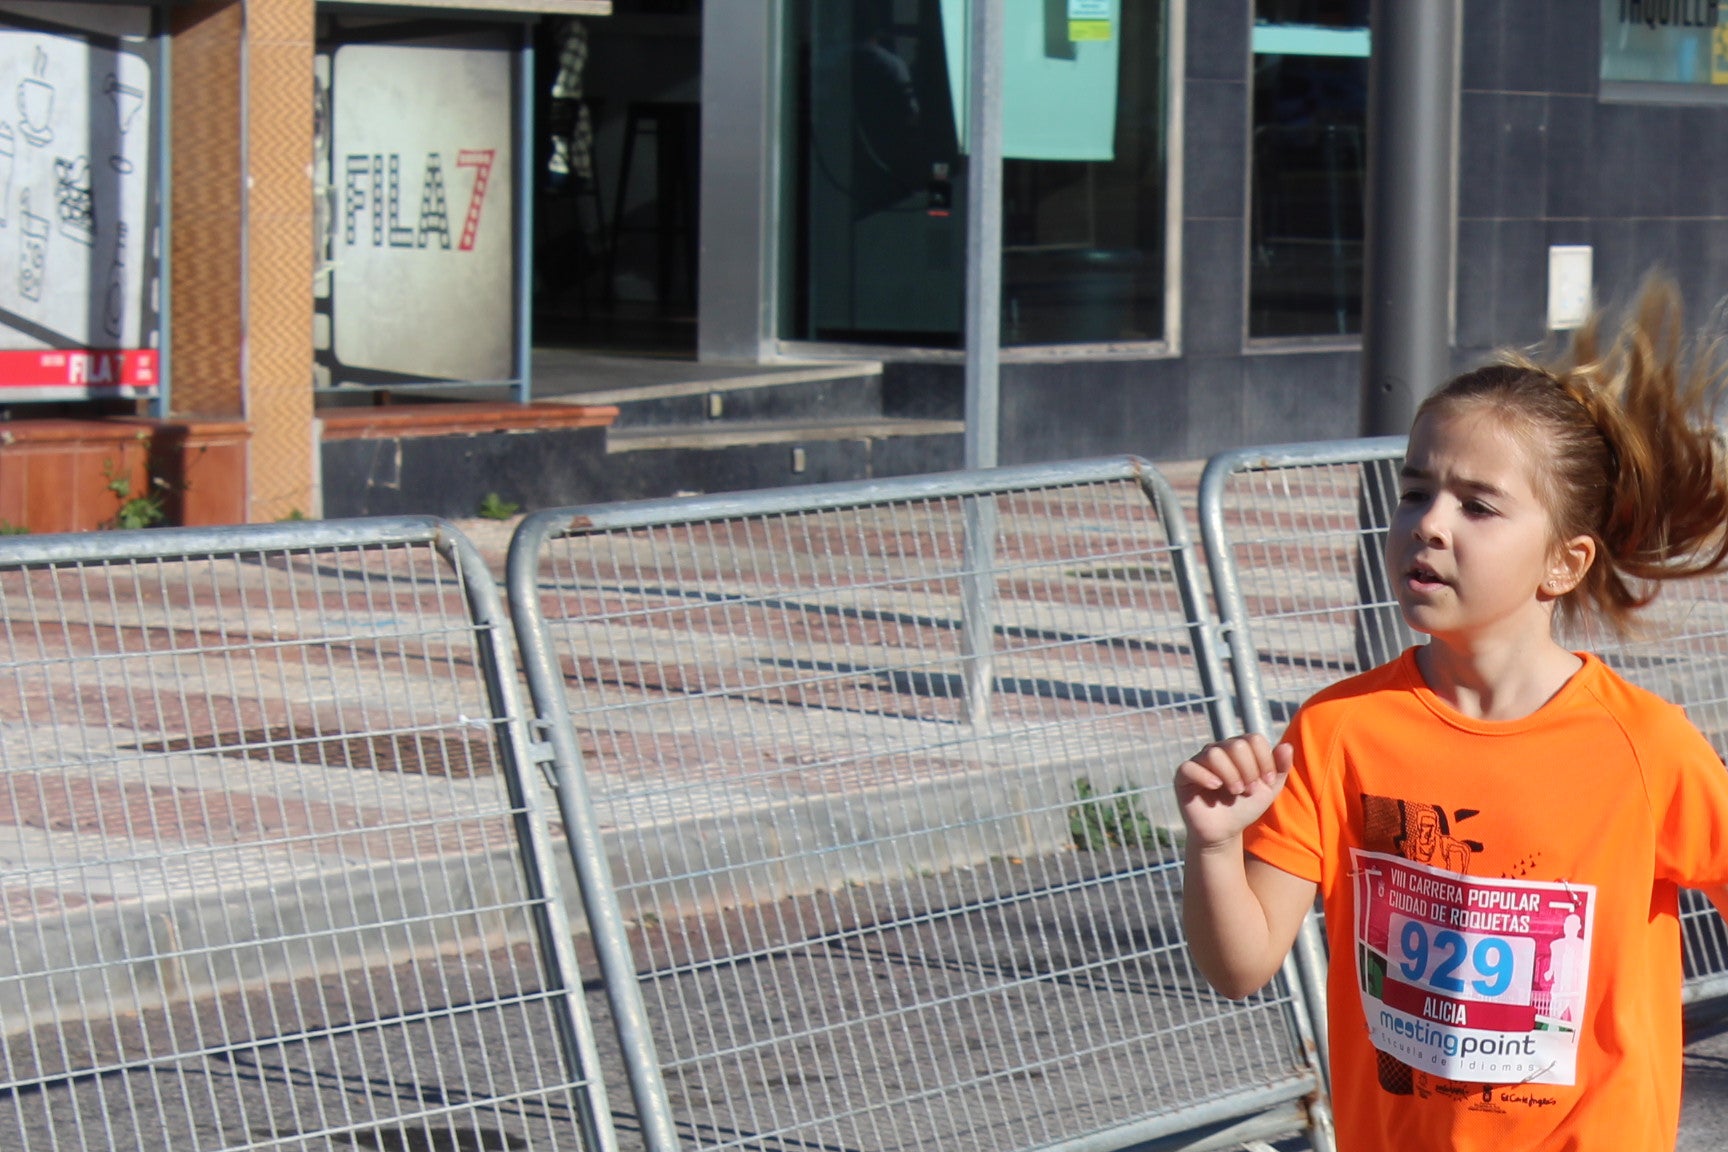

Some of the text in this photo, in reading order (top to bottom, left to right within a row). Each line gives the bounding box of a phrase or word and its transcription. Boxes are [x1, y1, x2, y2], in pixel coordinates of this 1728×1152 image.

[1391, 868, 1540, 911] VIII CARRERA POPULAR
[1389, 890, 1530, 933] CIUDAD DE ROQUETAS
[1400, 921, 1514, 996] 929
[1423, 997, 1467, 1026] ALICIA
[1380, 1009, 1536, 1058] meetingpoint
[1432, 1055, 1447, 1066] de
